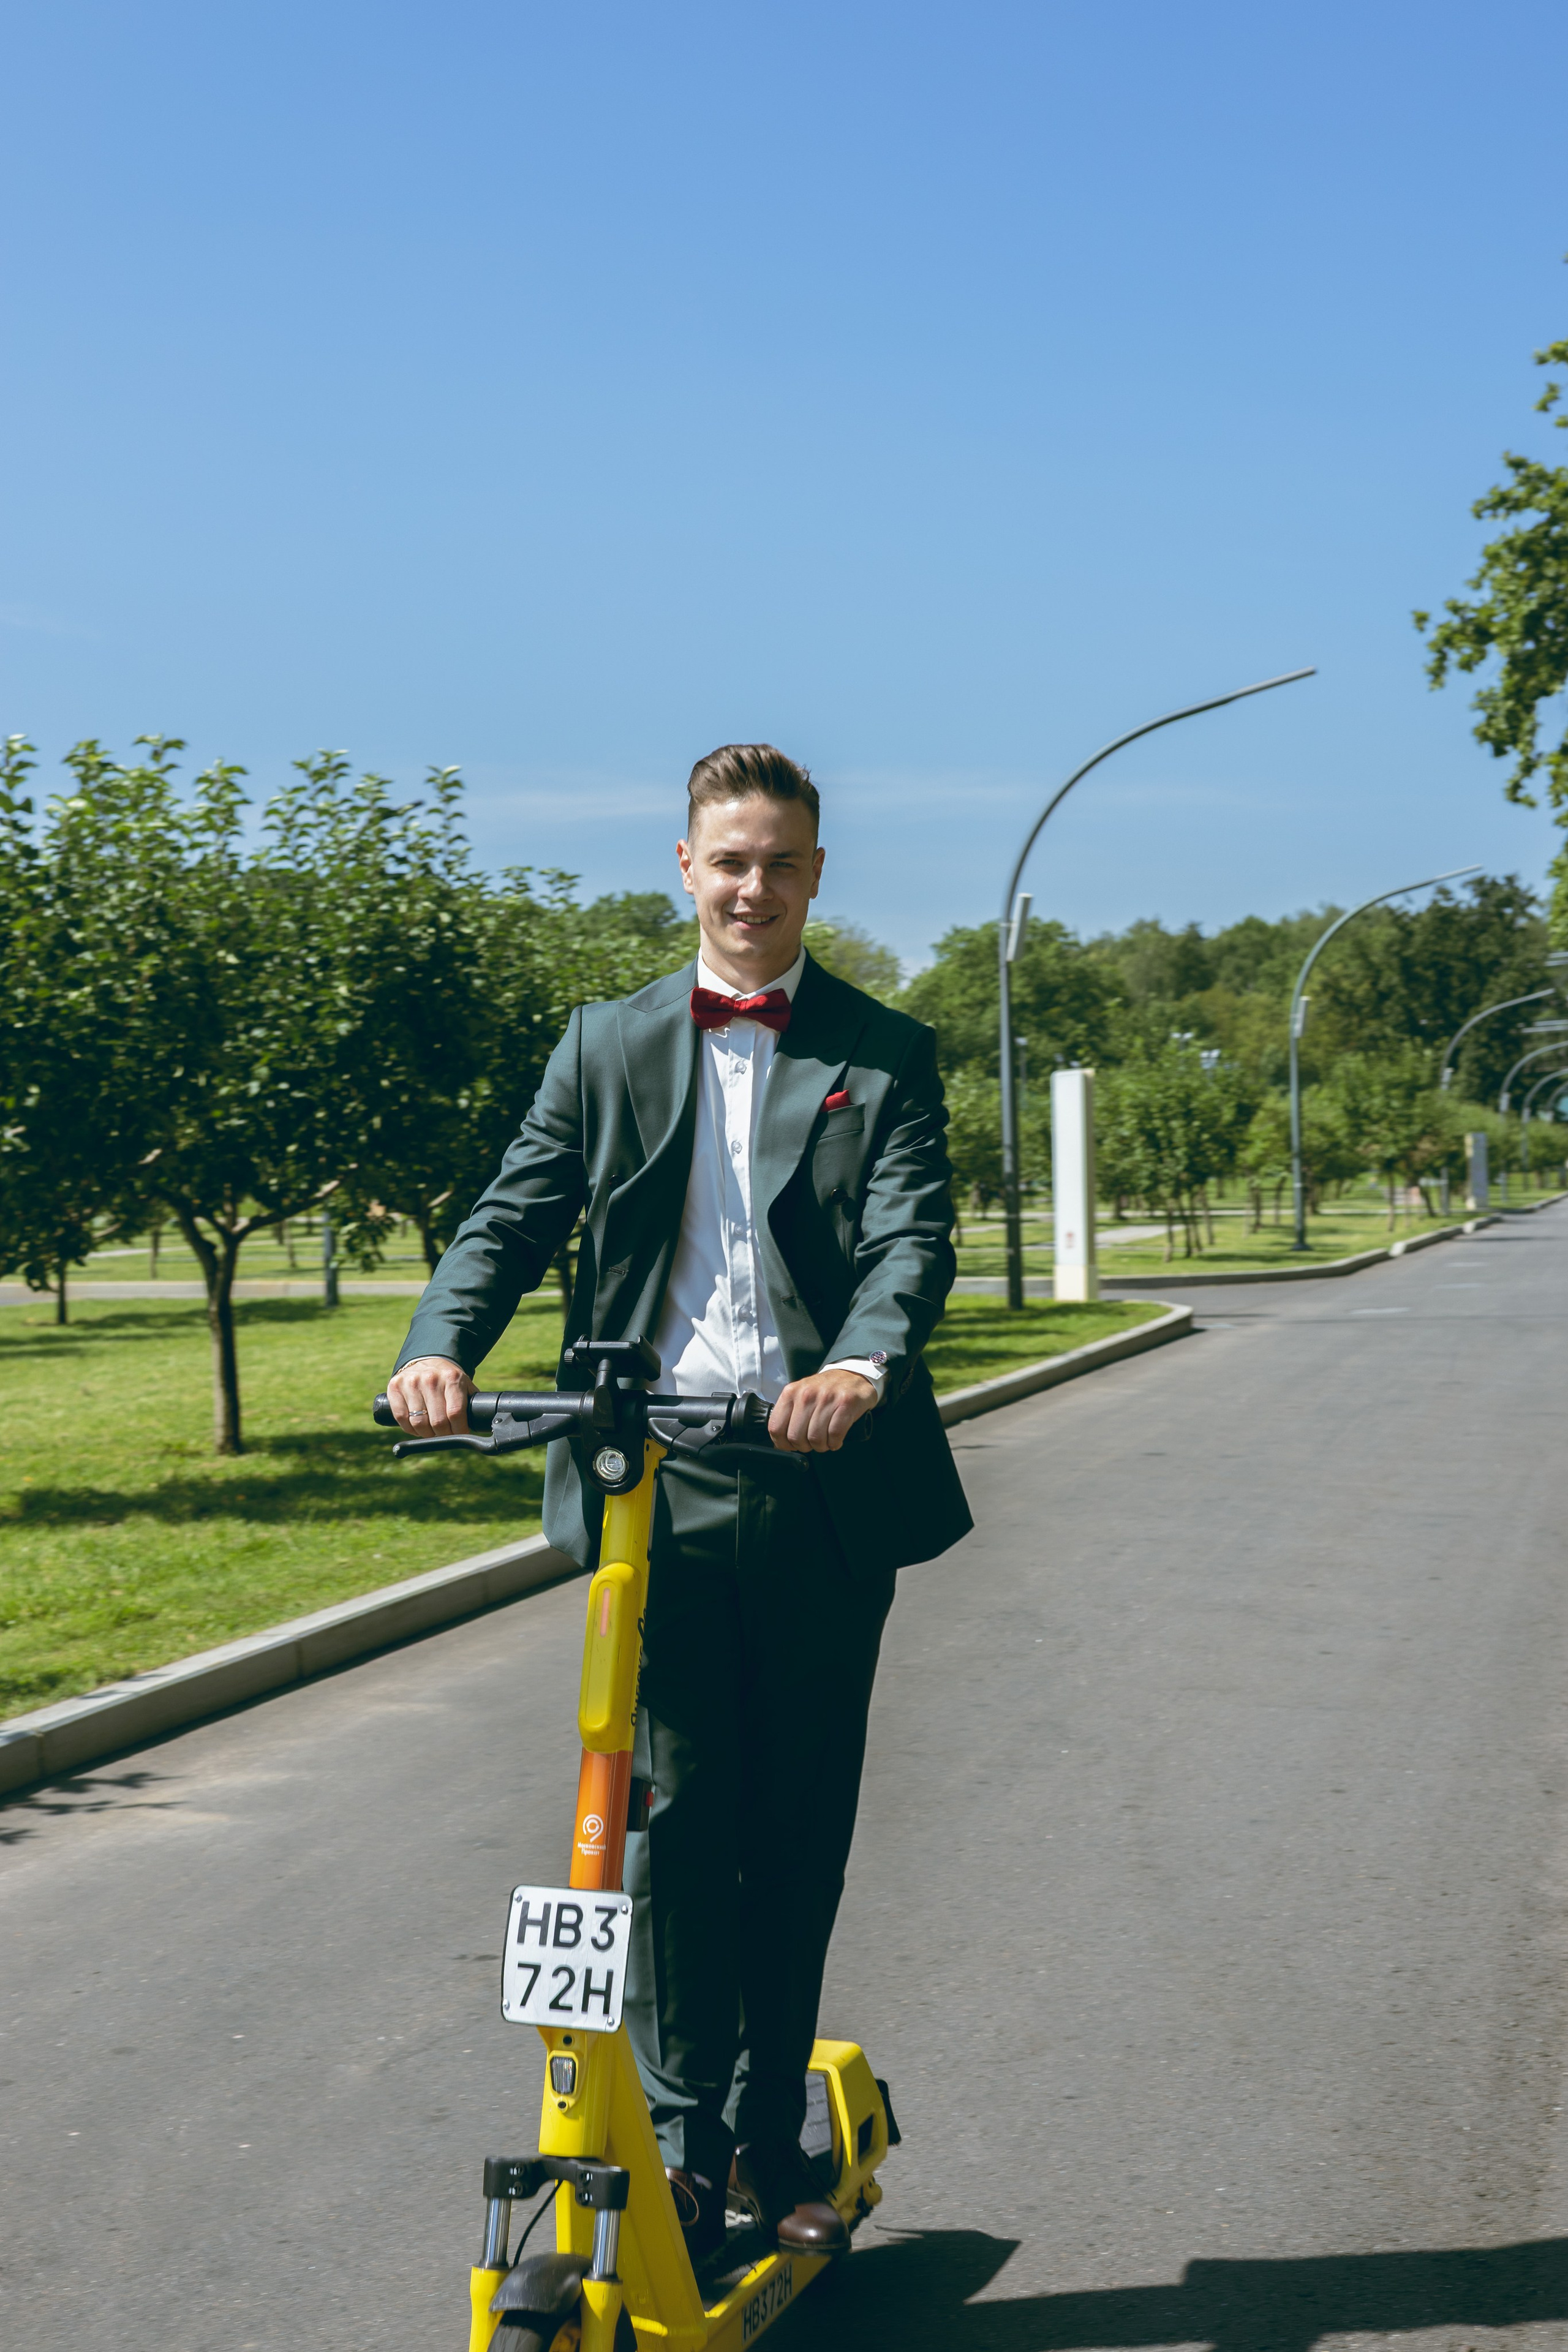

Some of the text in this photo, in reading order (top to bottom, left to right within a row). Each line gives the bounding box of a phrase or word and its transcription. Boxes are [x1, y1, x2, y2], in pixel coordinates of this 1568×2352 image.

[516, 1901, 618, 1951] HB3
[517, 1962, 614, 2015] 72H
[744, 2262, 793, 2342] HB372H
